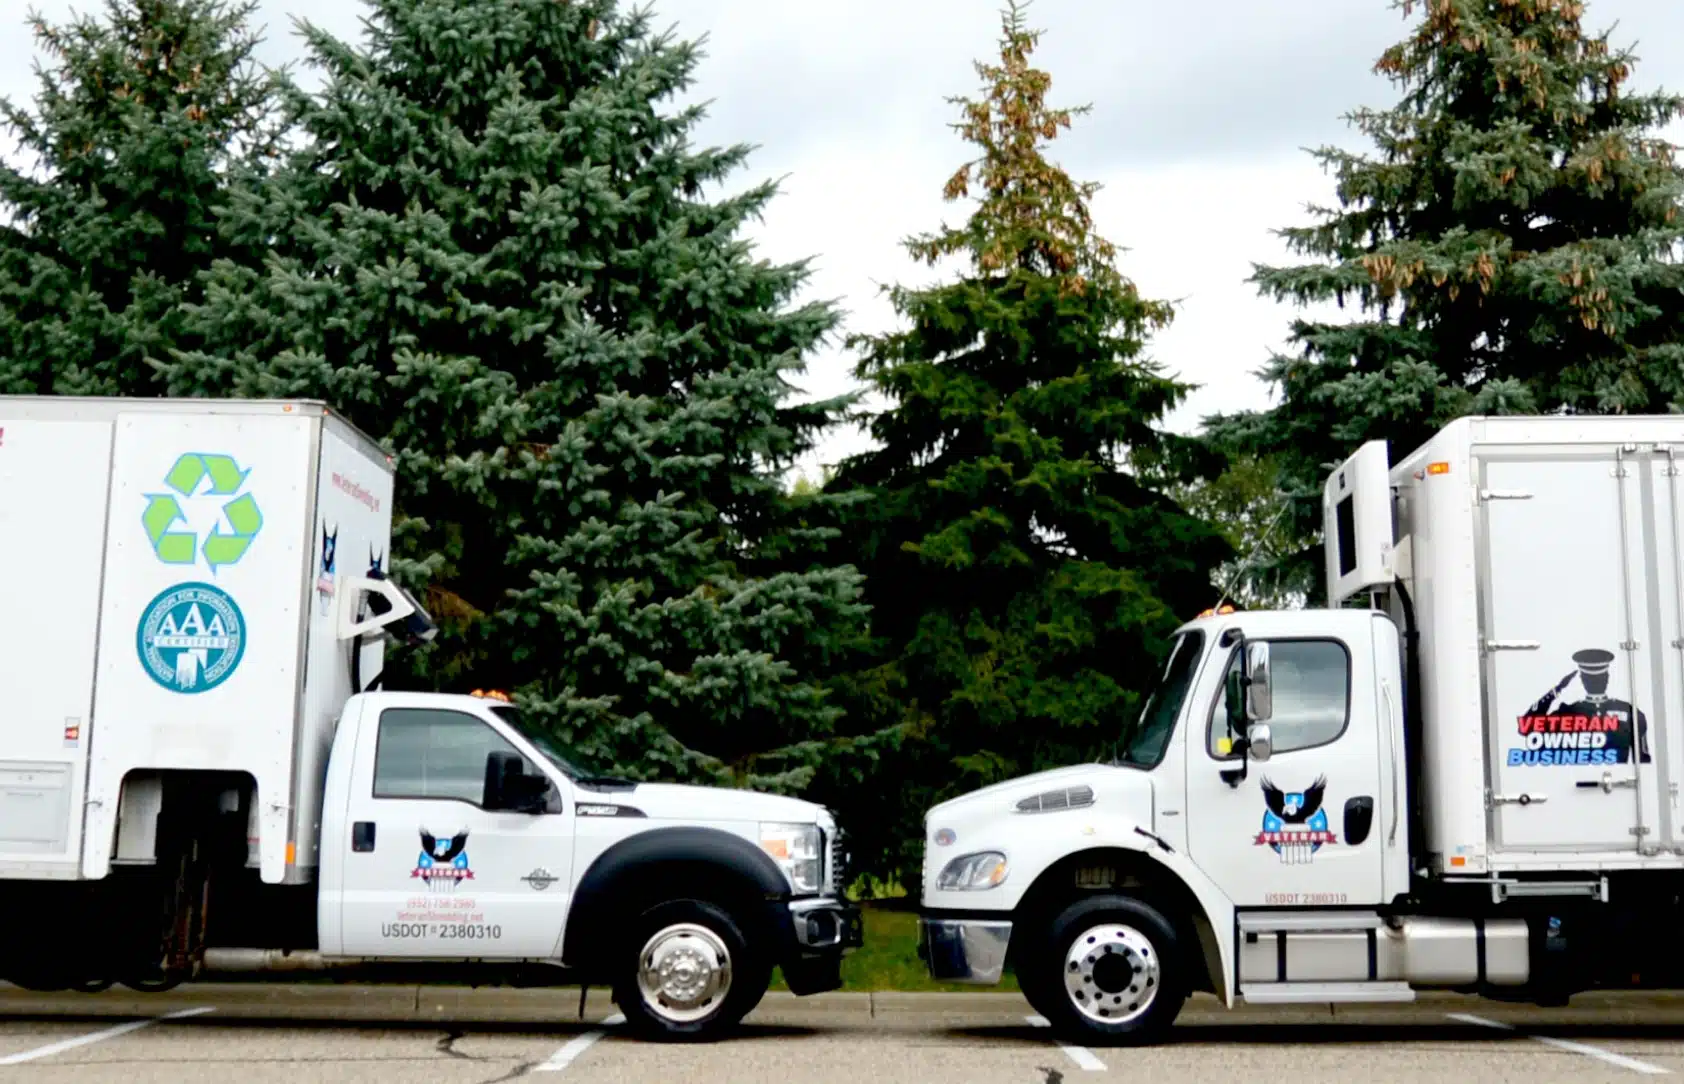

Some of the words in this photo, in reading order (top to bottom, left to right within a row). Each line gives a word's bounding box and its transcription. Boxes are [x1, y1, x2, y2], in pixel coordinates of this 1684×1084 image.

[157, 601, 226, 636] AAA
[1517, 715, 1619, 733] VETERAN
[1527, 732, 1607, 750] OWNED
[1507, 748, 1618, 766] BUSINESS
[1263, 832, 1327, 842] VETERAN
[1265, 892, 1299, 904] USDOT
[381, 923, 427, 938] USDOT
[439, 923, 502, 939] 2380310
